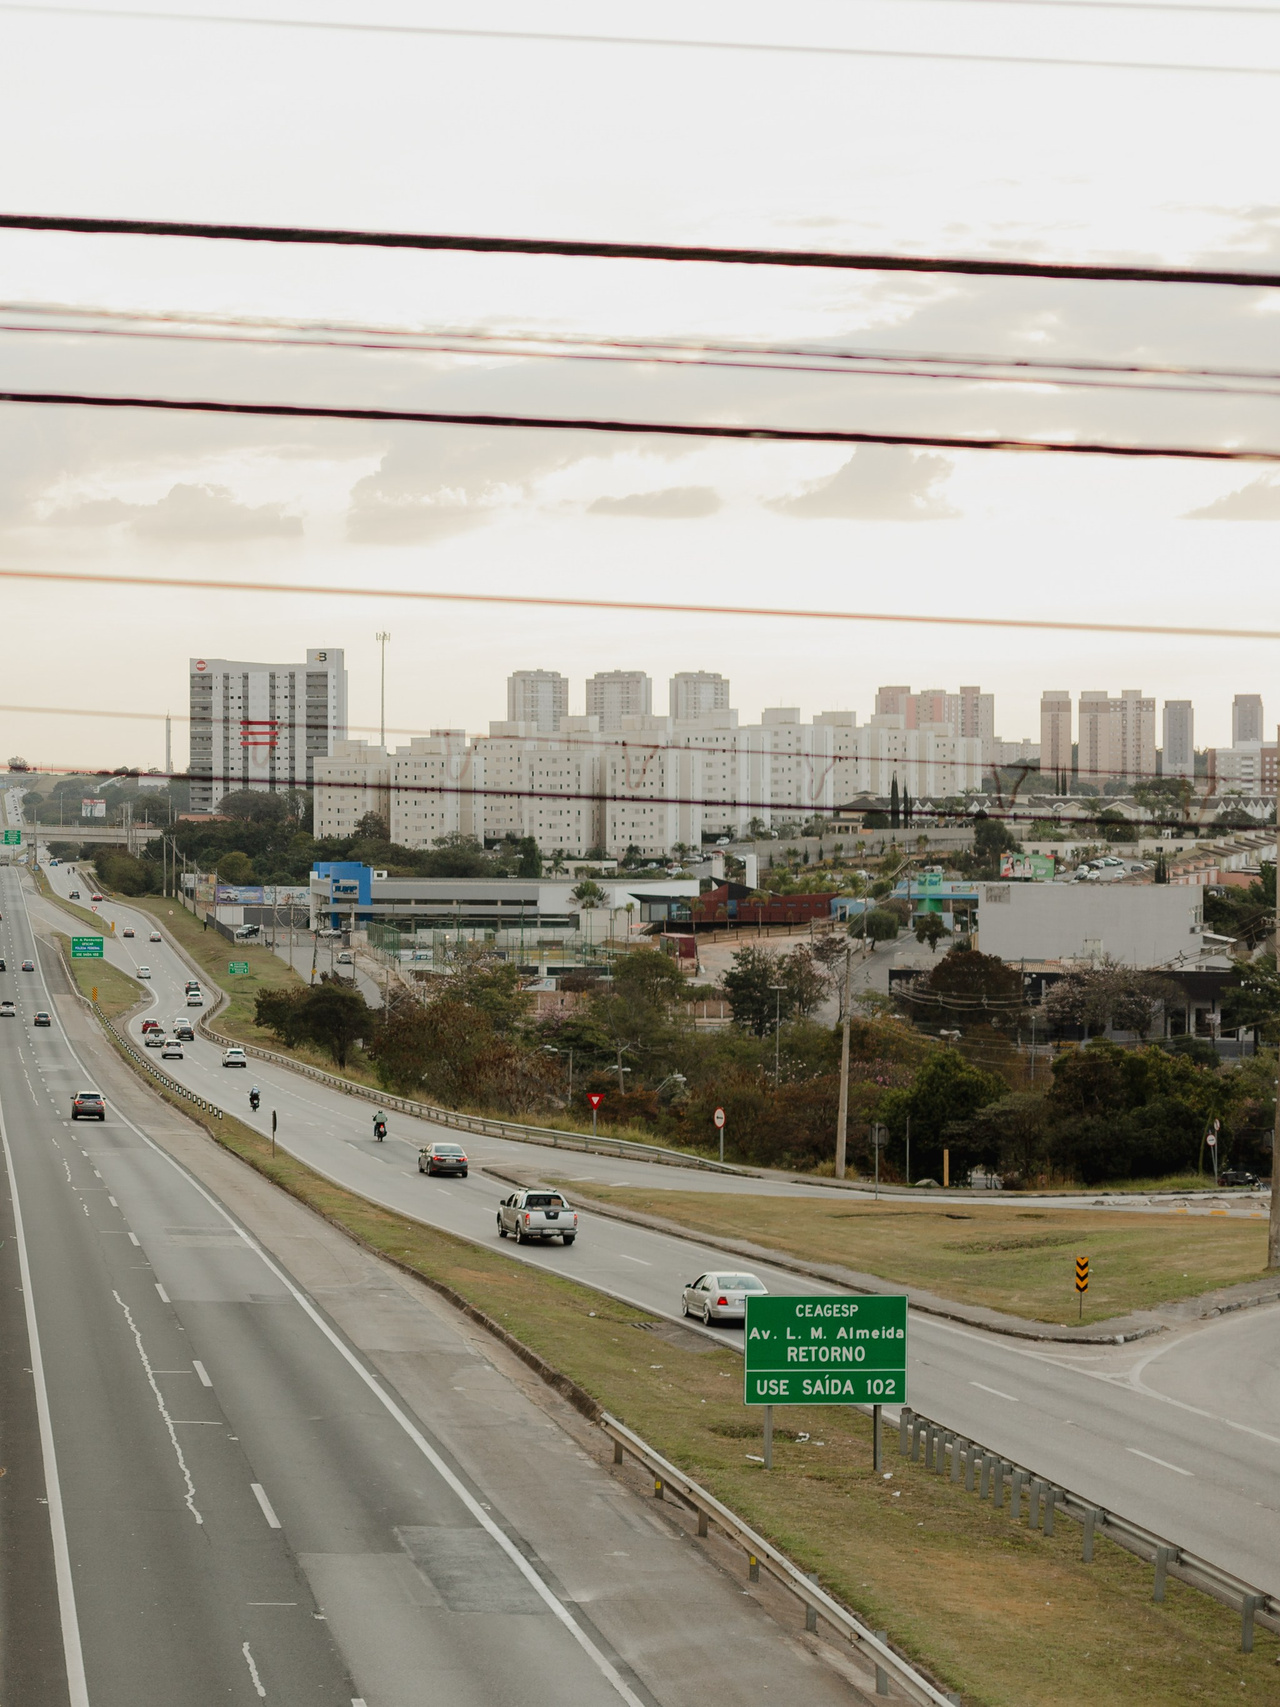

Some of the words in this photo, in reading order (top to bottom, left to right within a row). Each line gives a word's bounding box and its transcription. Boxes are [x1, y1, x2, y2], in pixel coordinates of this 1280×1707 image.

[796, 1304, 859, 1317] CEAGESP
[749, 1327, 777, 1340] Av.
[786, 1327, 802, 1339] L.
[811, 1327, 827, 1339] M.
[836, 1326, 904, 1339] Almeida
[787, 1346, 866, 1362] RETORNO
[756, 1379, 789, 1395] USE
[802, 1374, 854, 1395] SAÍDA
[866, 1379, 896, 1395] 102
